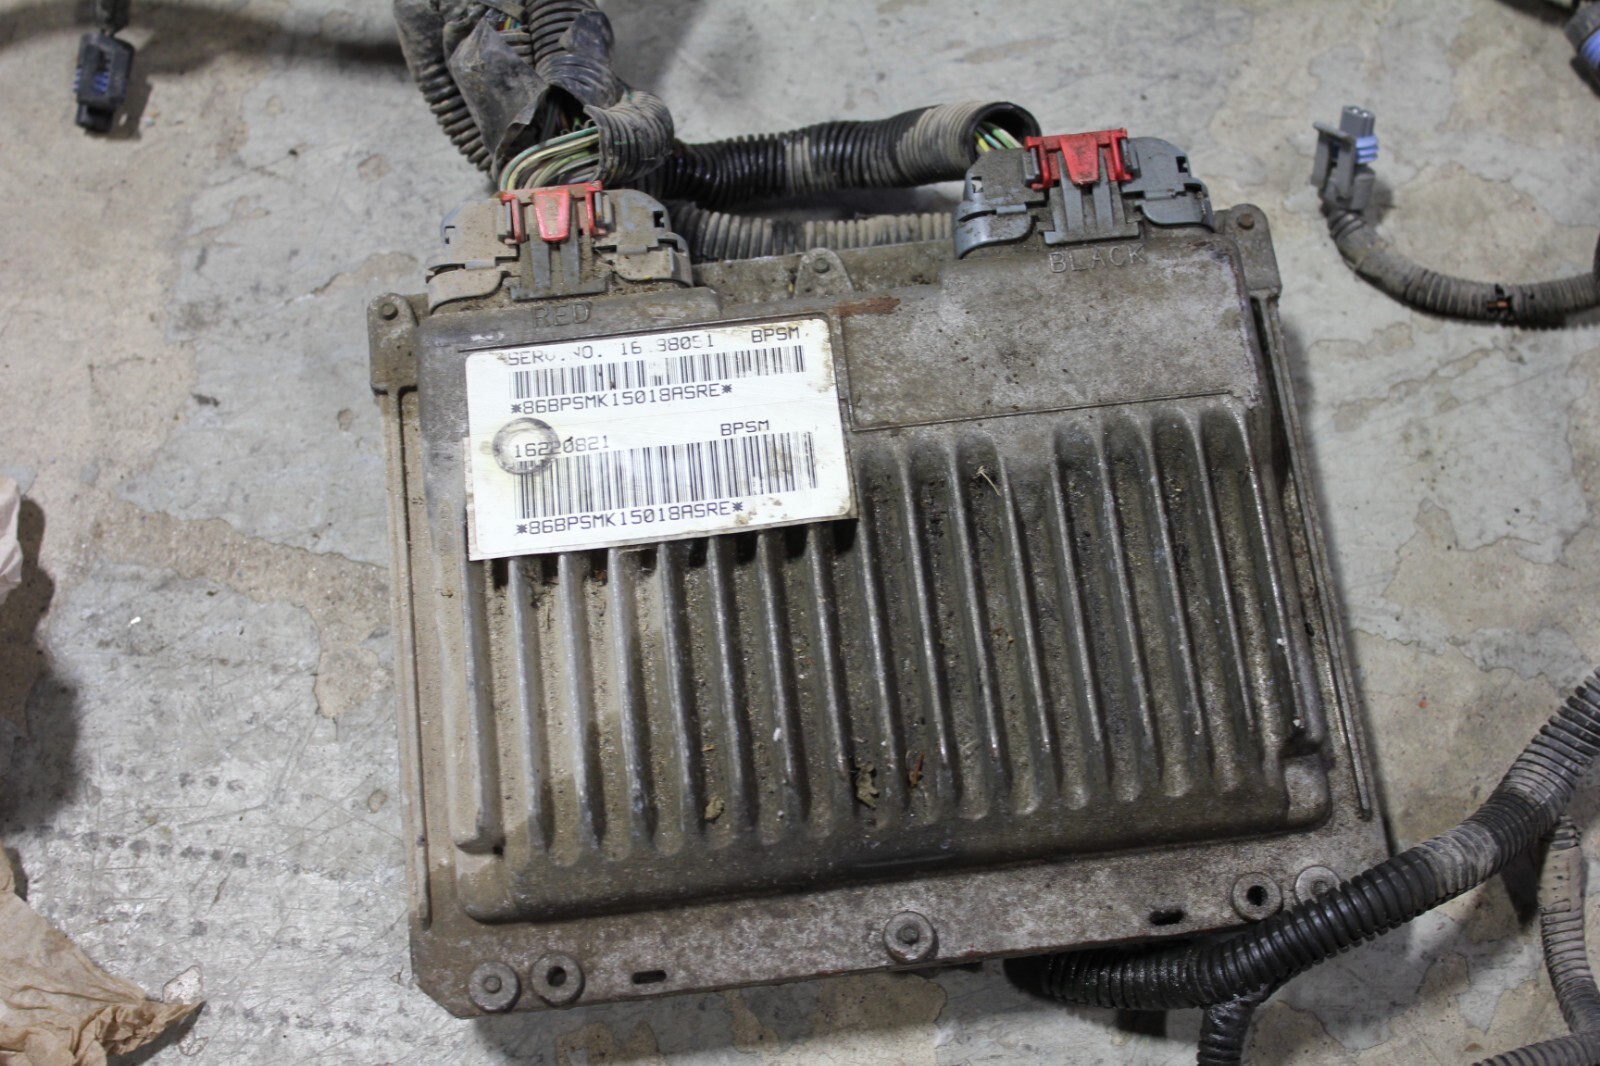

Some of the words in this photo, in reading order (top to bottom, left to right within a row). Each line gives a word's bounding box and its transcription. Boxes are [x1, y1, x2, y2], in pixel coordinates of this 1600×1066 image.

[1049, 243, 1147, 273] BLACK
[532, 301, 592, 328] RED
[751, 326, 800, 343] BPSM
[720, 420, 769, 436] BPSM
[515, 435, 609, 458] 16220821
